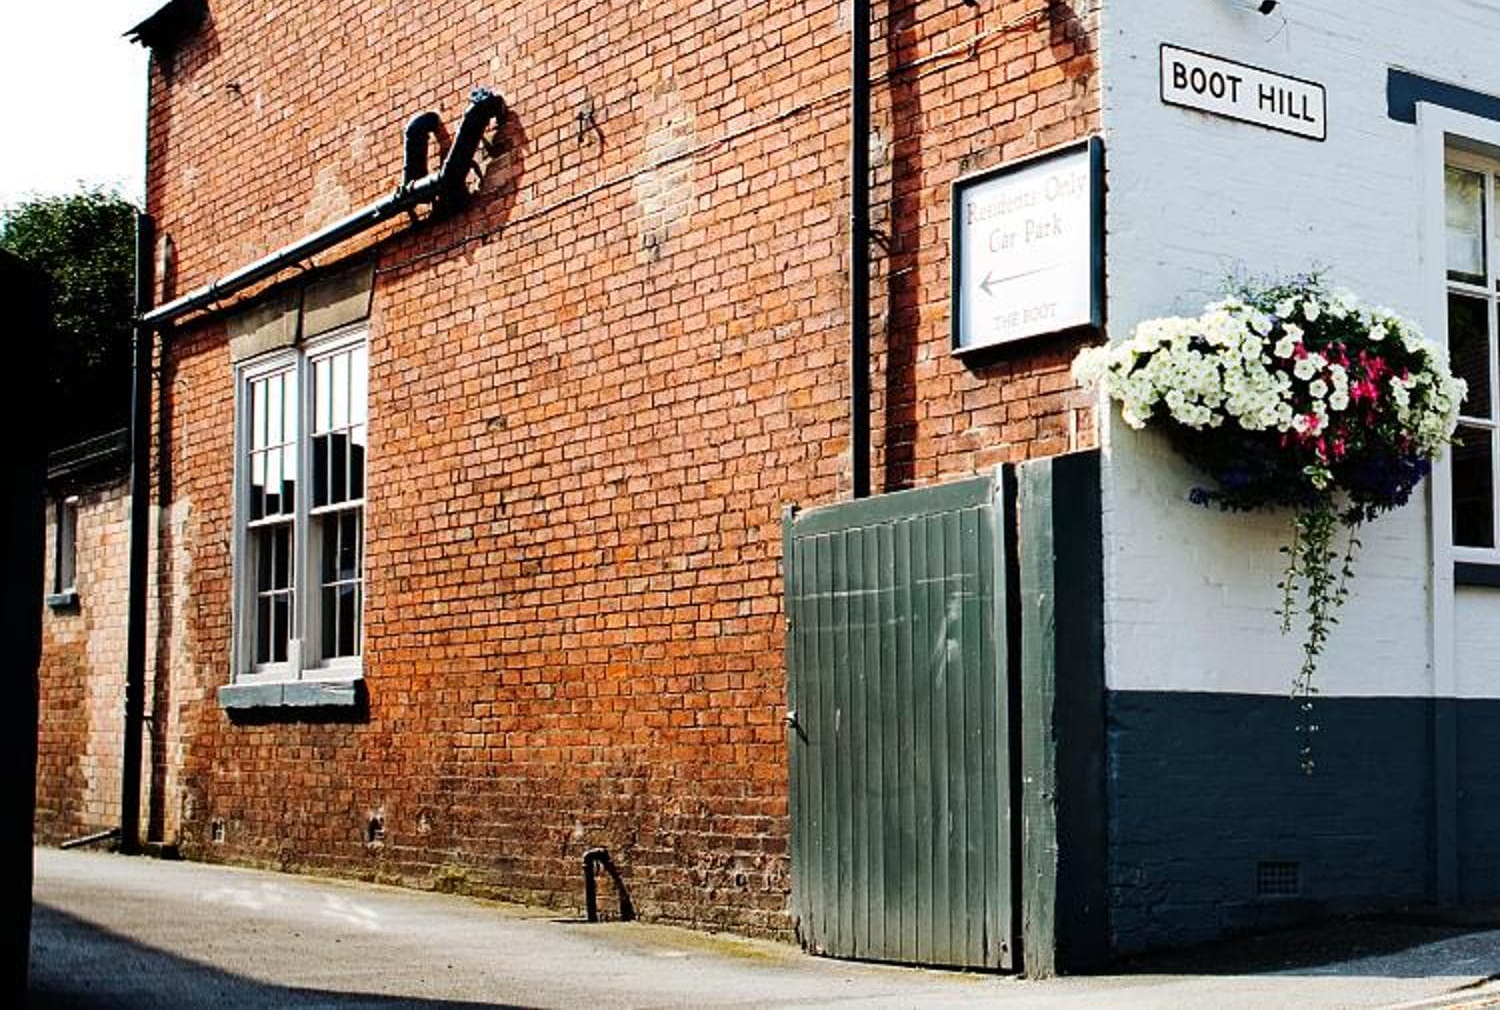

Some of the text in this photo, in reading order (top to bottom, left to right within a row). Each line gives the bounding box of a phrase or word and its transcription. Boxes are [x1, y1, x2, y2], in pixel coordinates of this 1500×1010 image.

[1173, 61, 1316, 123] BOOT HILL
[988, 212, 1063, 253] Car Park
